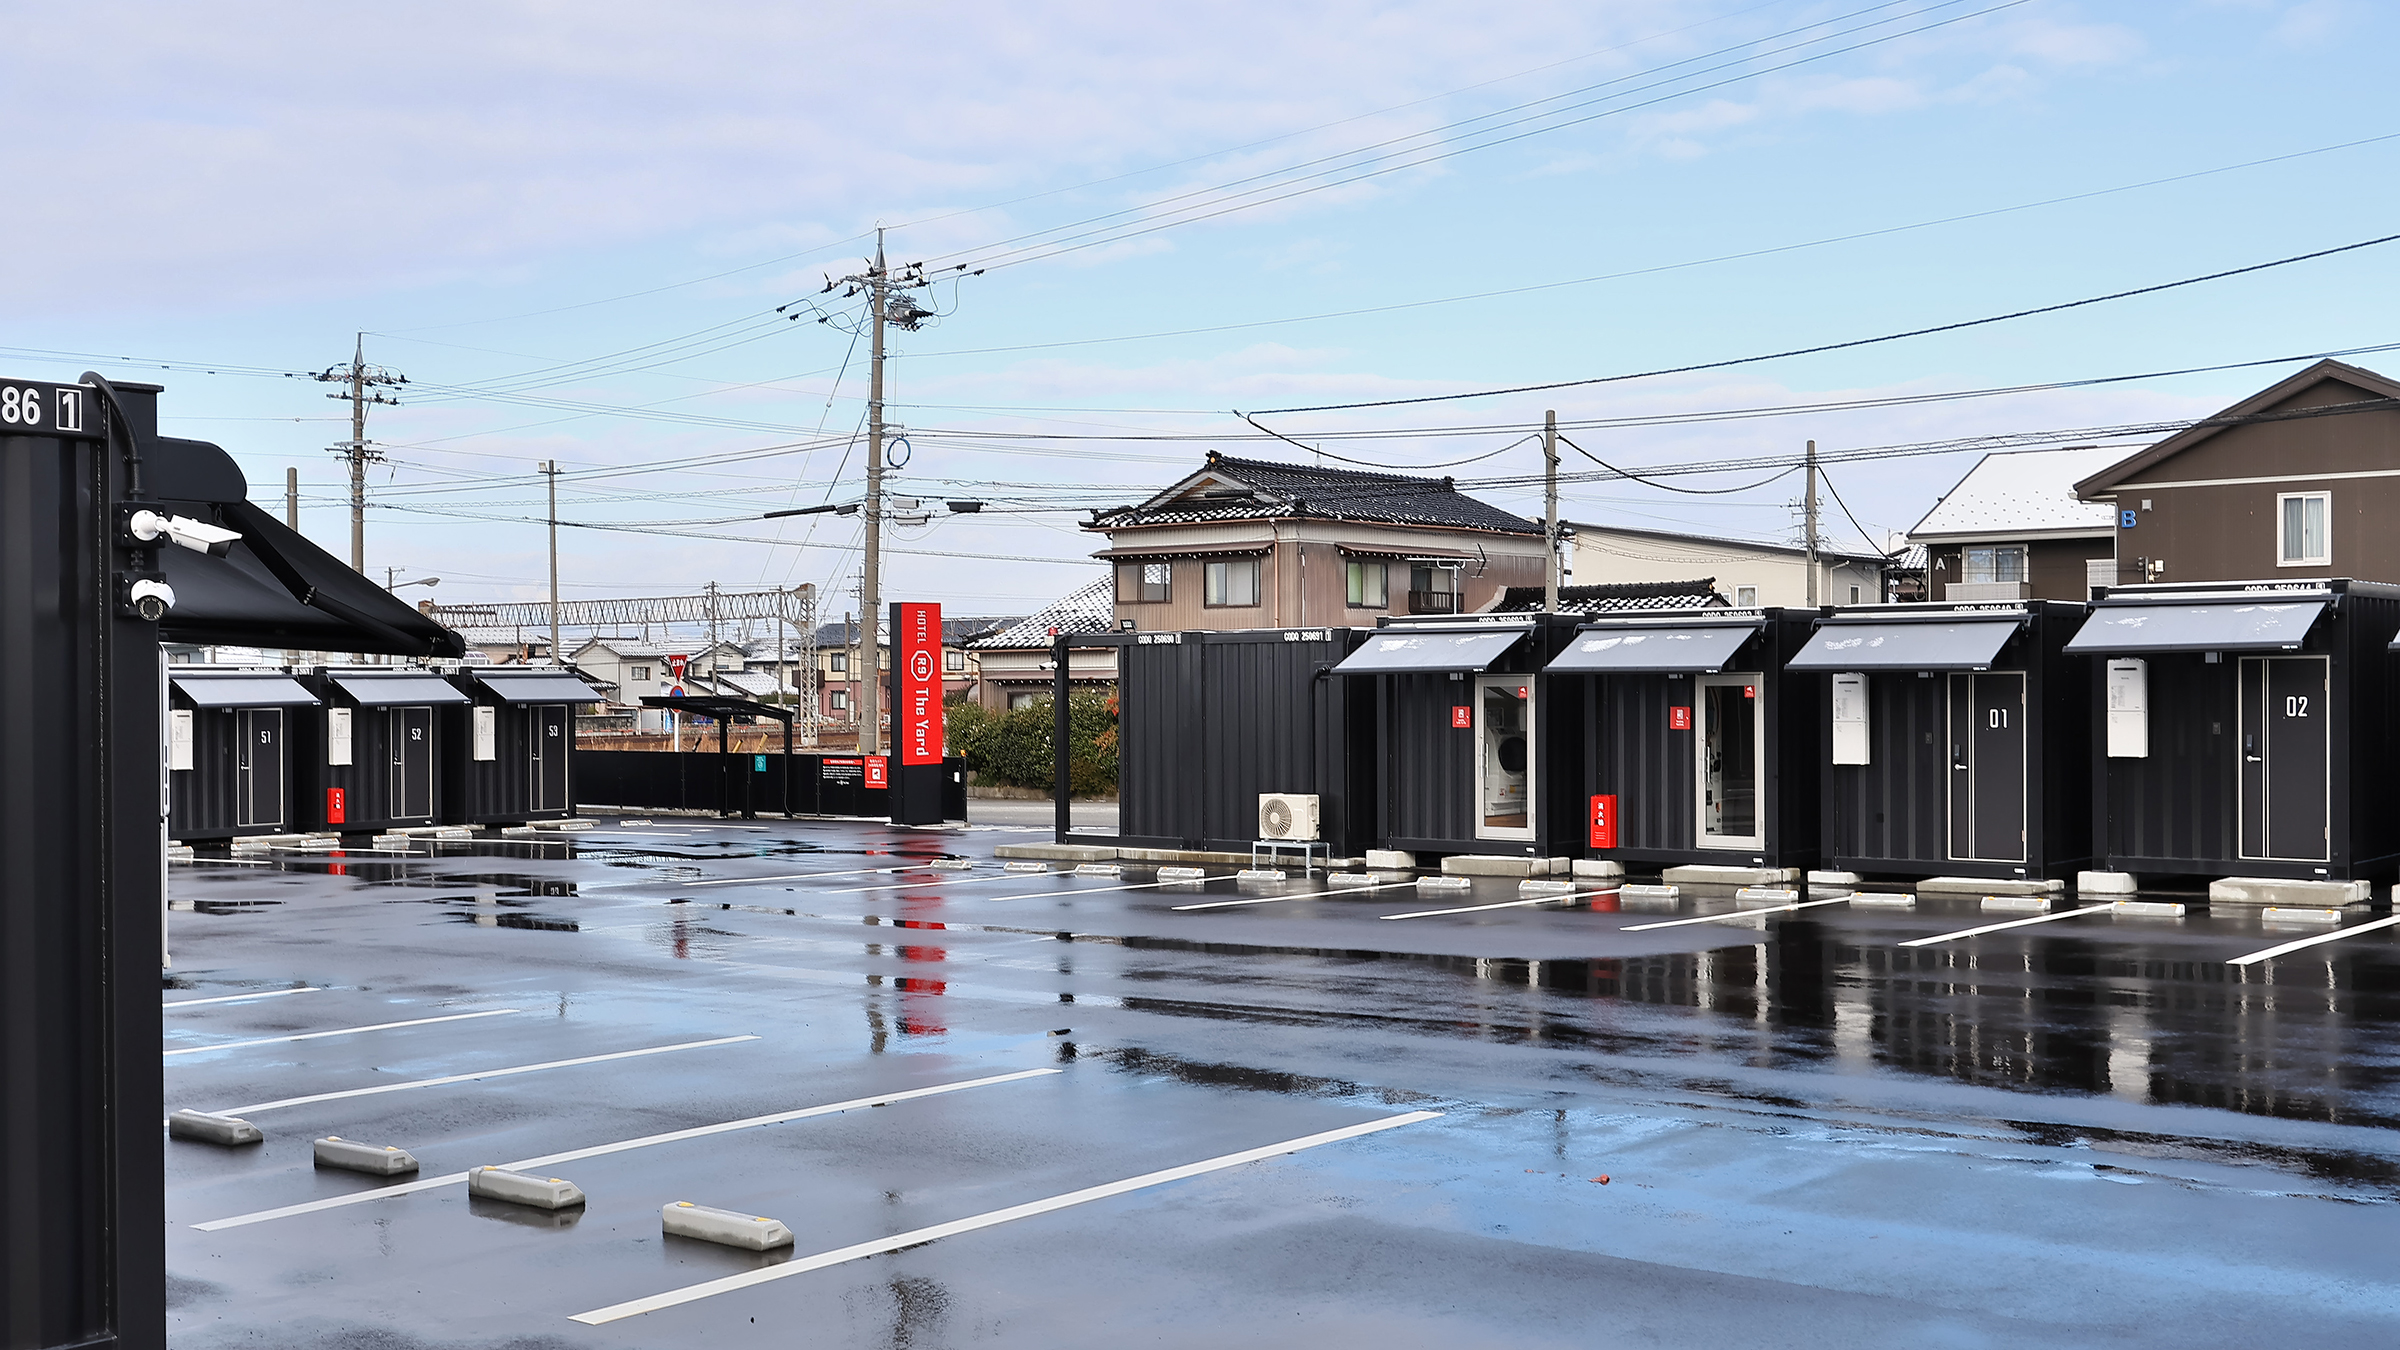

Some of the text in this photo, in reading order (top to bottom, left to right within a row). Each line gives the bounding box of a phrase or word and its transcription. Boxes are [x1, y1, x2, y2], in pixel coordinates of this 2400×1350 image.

[1, 386, 41, 425] 86
[2121, 510, 2137, 528] B
[1935, 557, 1946, 571] A
[915, 610, 930, 757] HOTEL R9 The Yard
[2286, 696, 2308, 717] 02
[1989, 708, 2008, 728] 01
[260, 730, 271, 744] 51
[411, 728, 422, 741] 52
[548, 725, 558, 737] 53
